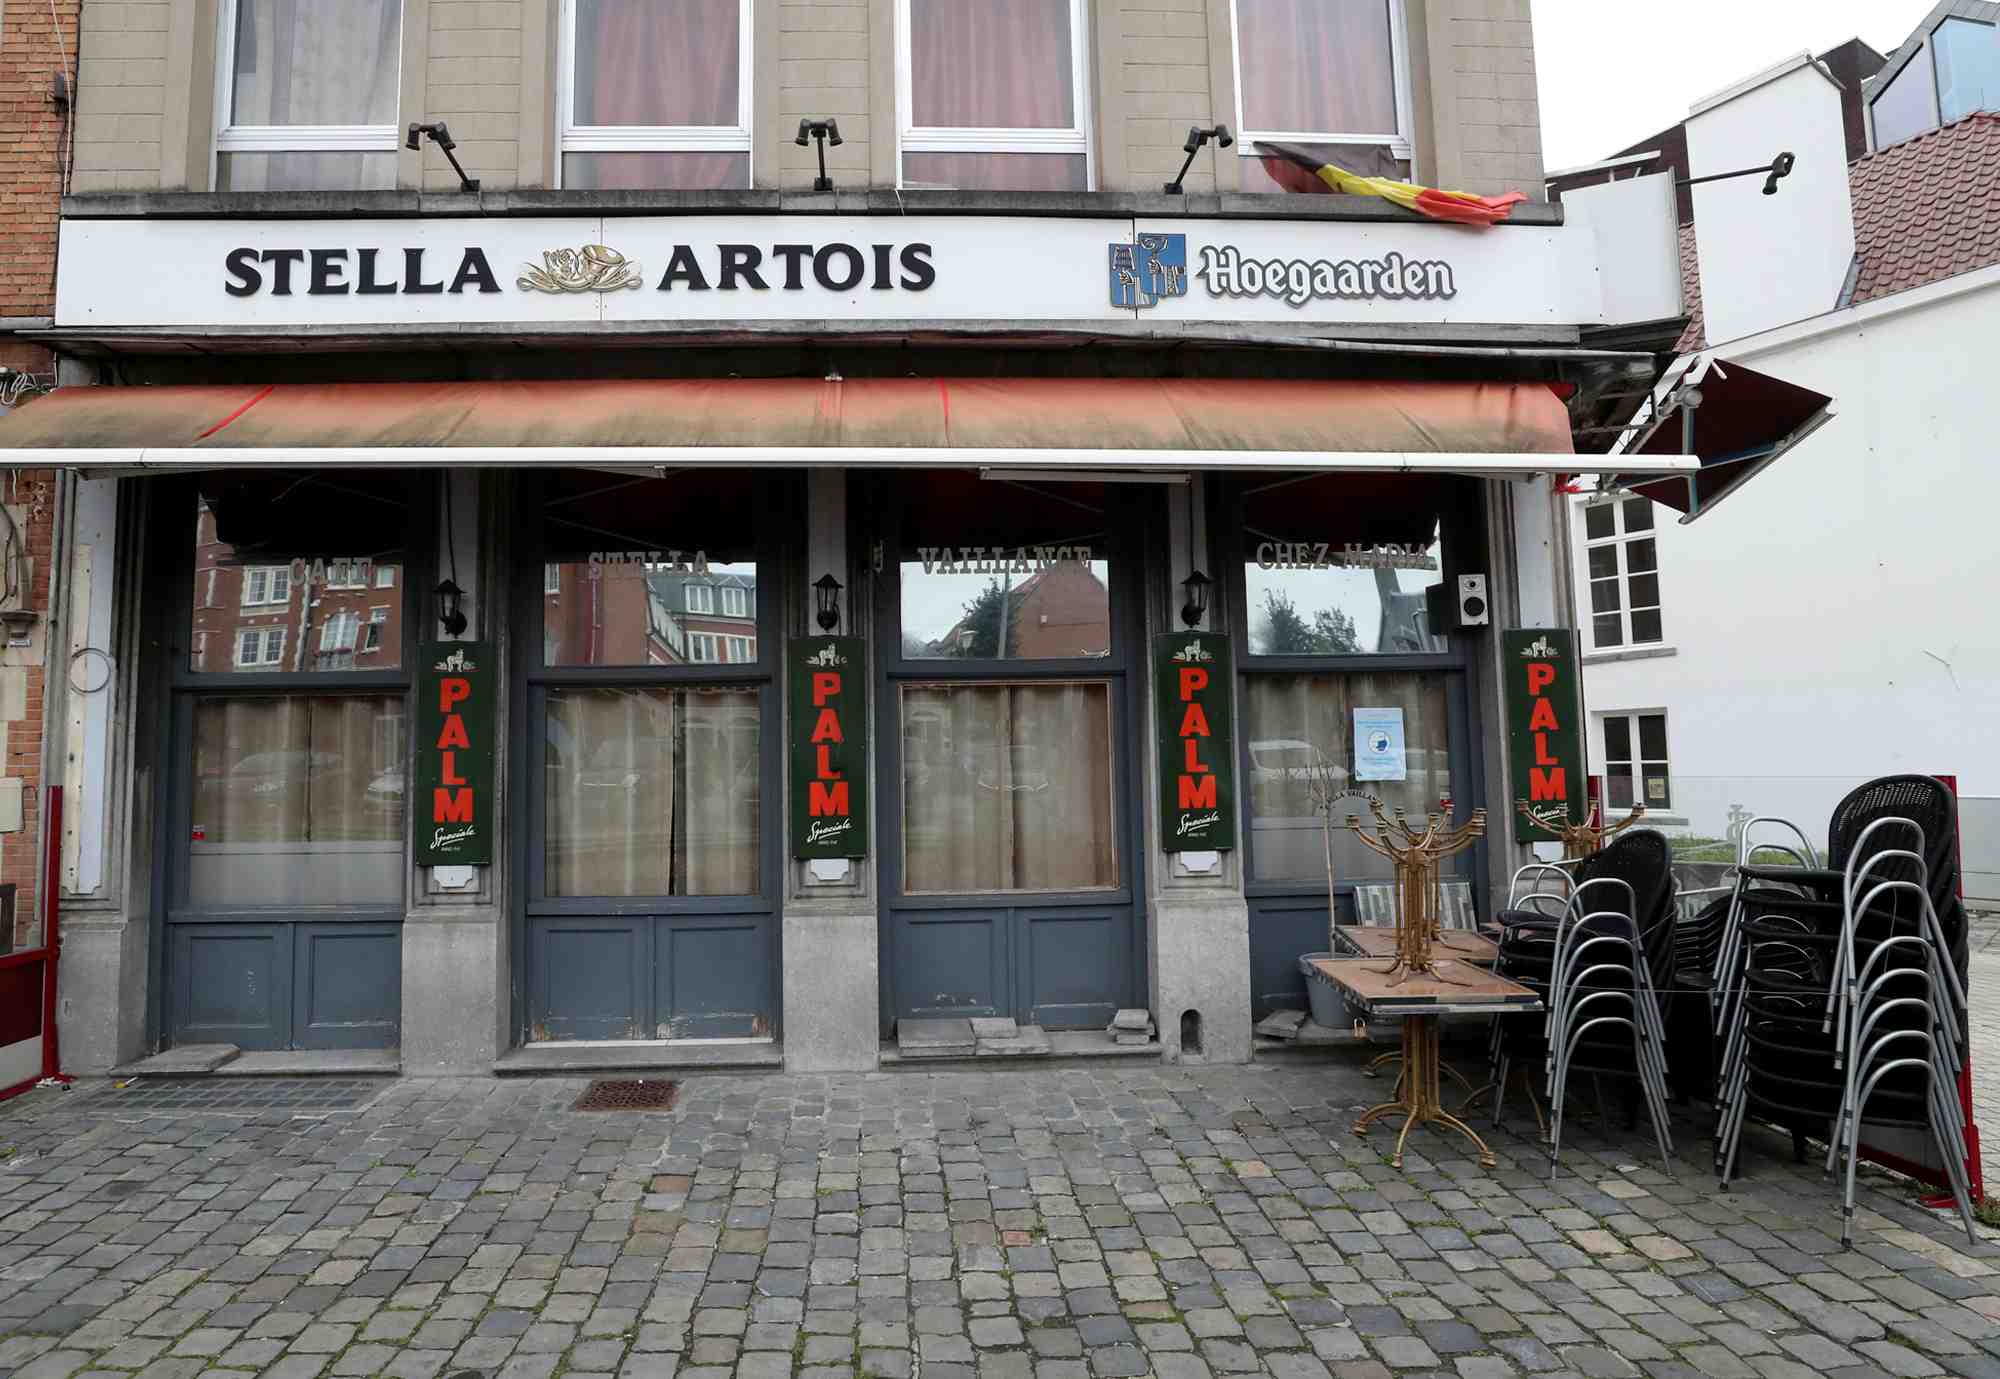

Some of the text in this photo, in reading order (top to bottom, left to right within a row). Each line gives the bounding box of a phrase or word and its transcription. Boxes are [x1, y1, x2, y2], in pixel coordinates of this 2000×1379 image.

[226, 244, 935, 298] STELLA ARTOIS
[1196, 246, 1458, 309] Hoegaarden
[1256, 542, 1329, 570] CHEZ
[435, 677, 473, 823] PALM
[811, 672, 849, 816] PALM
[1178, 667, 1217, 809] PALM
[1525, 664, 1566, 801] PALM
[430, 825, 476, 849] Speciale
[807, 818, 852, 843] Speciale
[1176, 811, 1221, 836] Speciale
